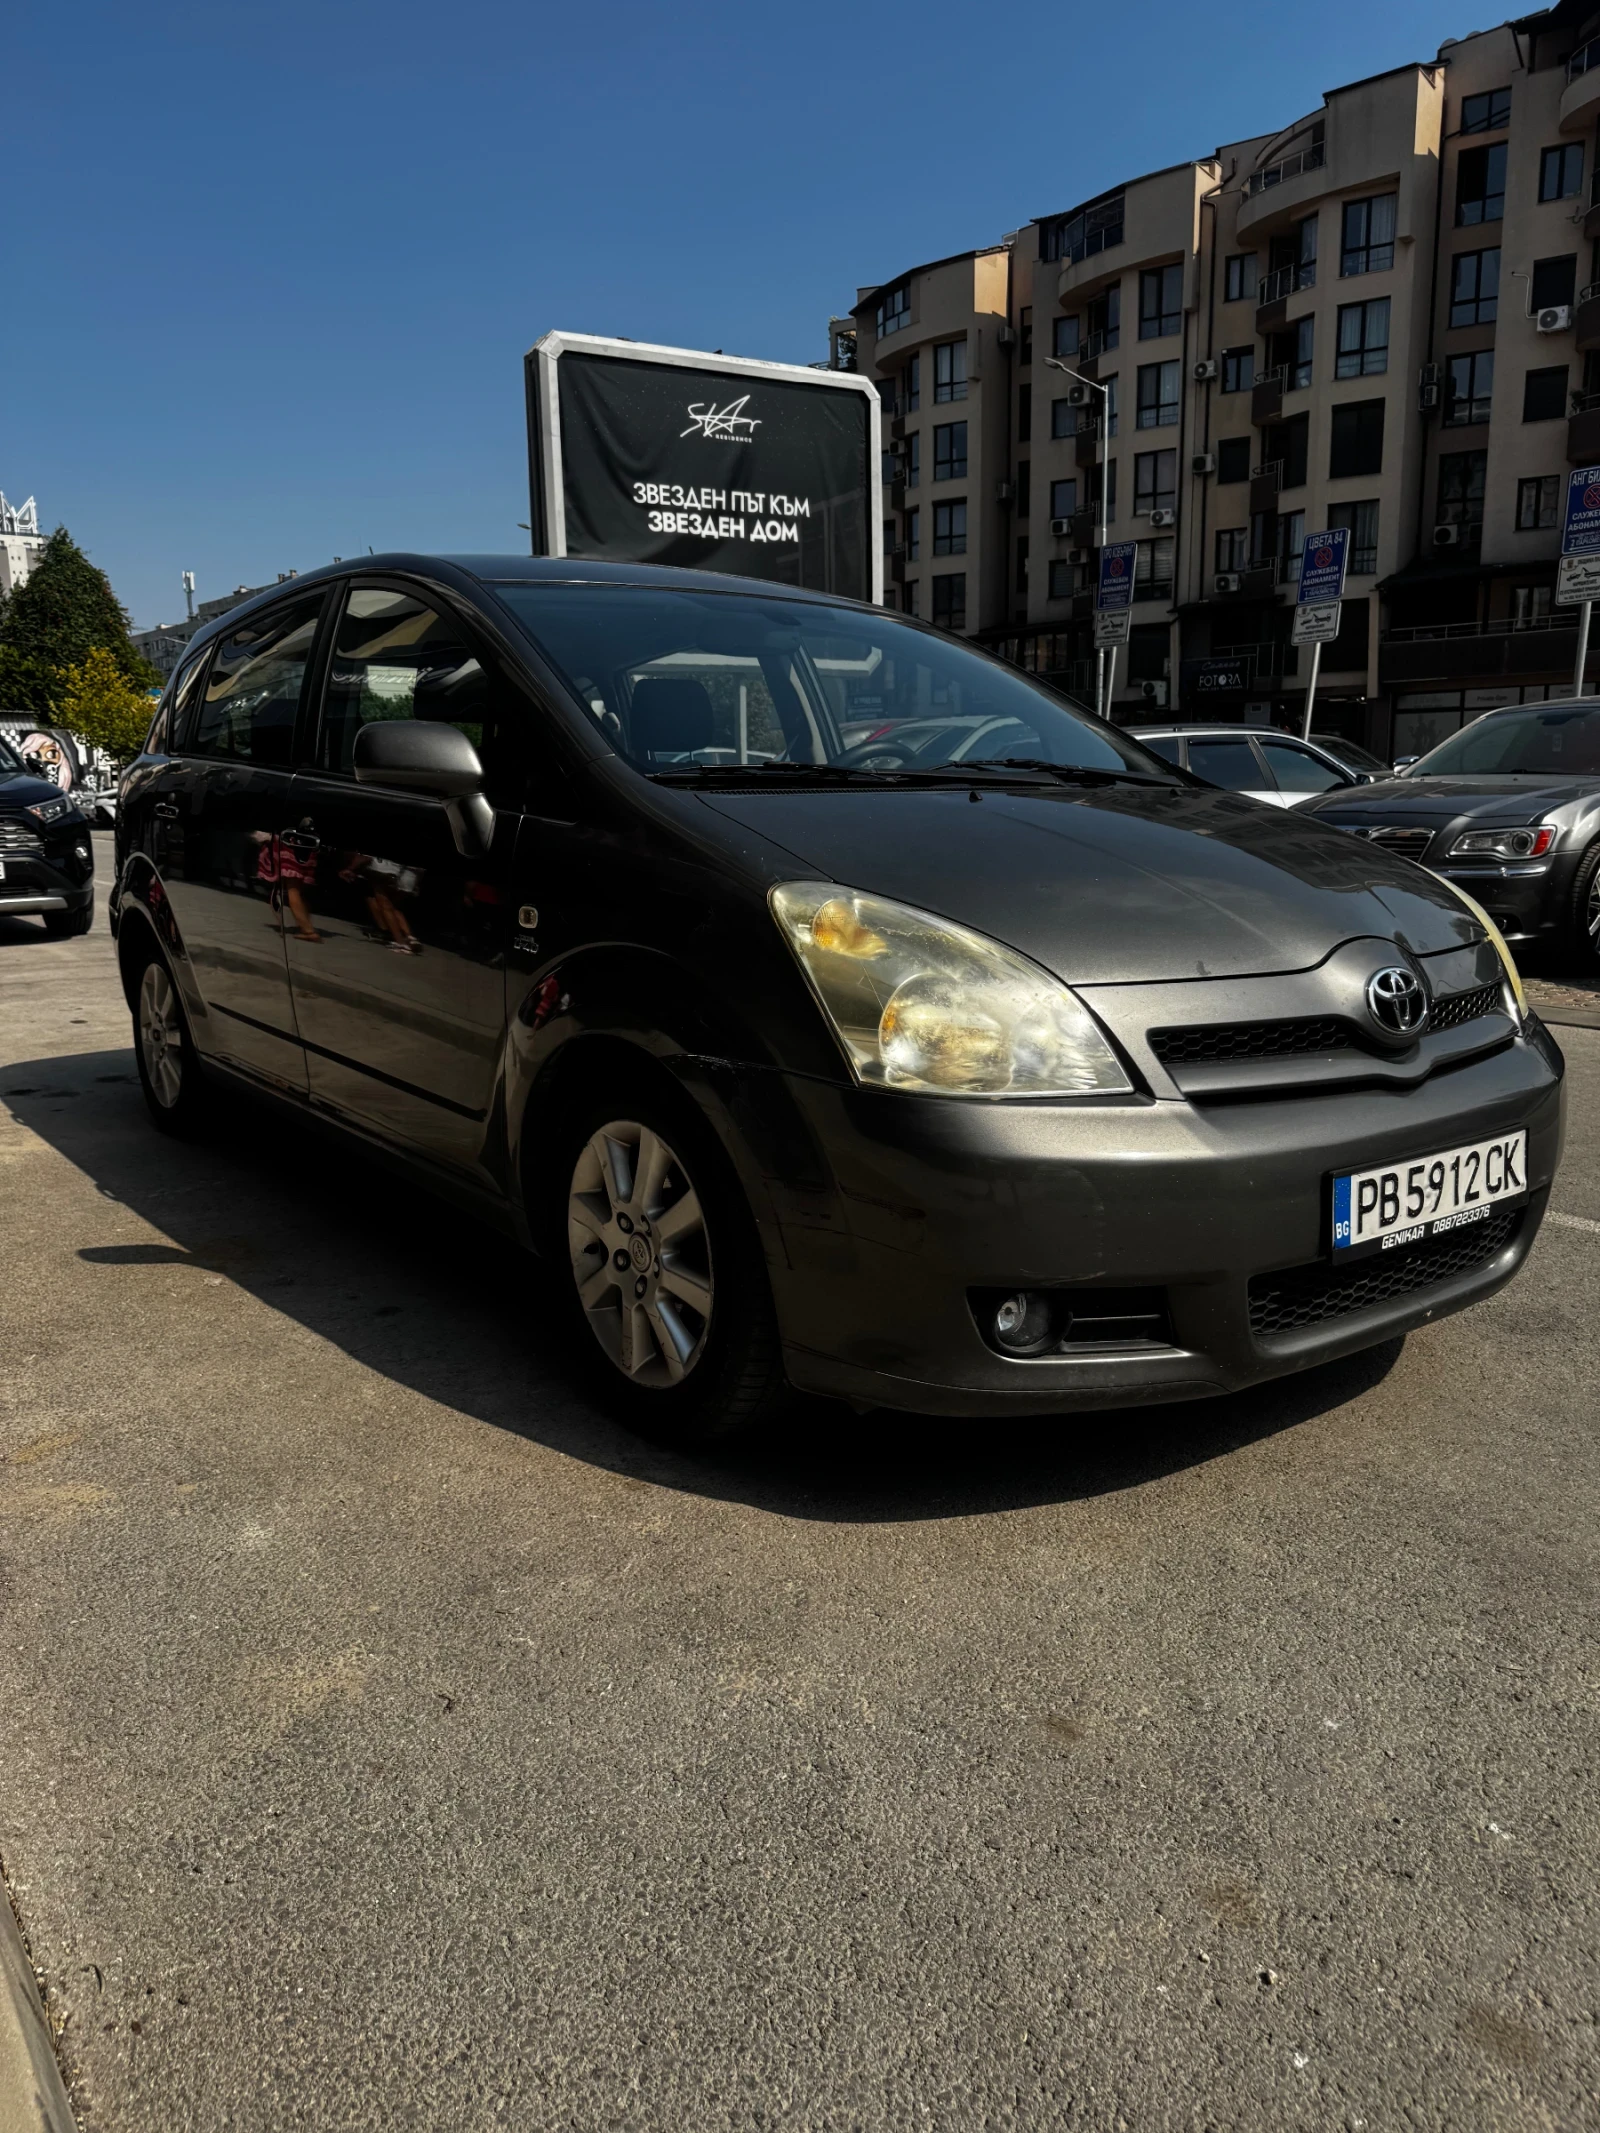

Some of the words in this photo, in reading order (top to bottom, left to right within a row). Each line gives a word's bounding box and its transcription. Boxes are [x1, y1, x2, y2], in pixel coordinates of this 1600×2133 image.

[715, 433, 753, 444] RESIDENCE
[1571, 472, 1587, 487] АНГ
[633, 482, 726, 511] ЗВЕЗДЕН
[731, 491, 766, 514] ПЪТ
[770, 494, 811, 518] КЪМ
[1572, 508, 1600, 521] СЛУЖЕ
[648, 511, 745, 539] ЗВЕЗДЕН
[750, 518, 799, 543] ДОМ
[1308, 533, 1333, 551] ЦВЕТА
[1334, 531, 1344, 545] 84
[1306, 565, 1338, 578] СЛУЖЕБЕН
[1302, 574, 1340, 587] АБОНАМЕНТ
[1335, 1220, 1349, 1240] BG
[1381, 1225, 1425, 1250] GENIKAR
[1432, 1204, 1491, 1235] 0887223376
